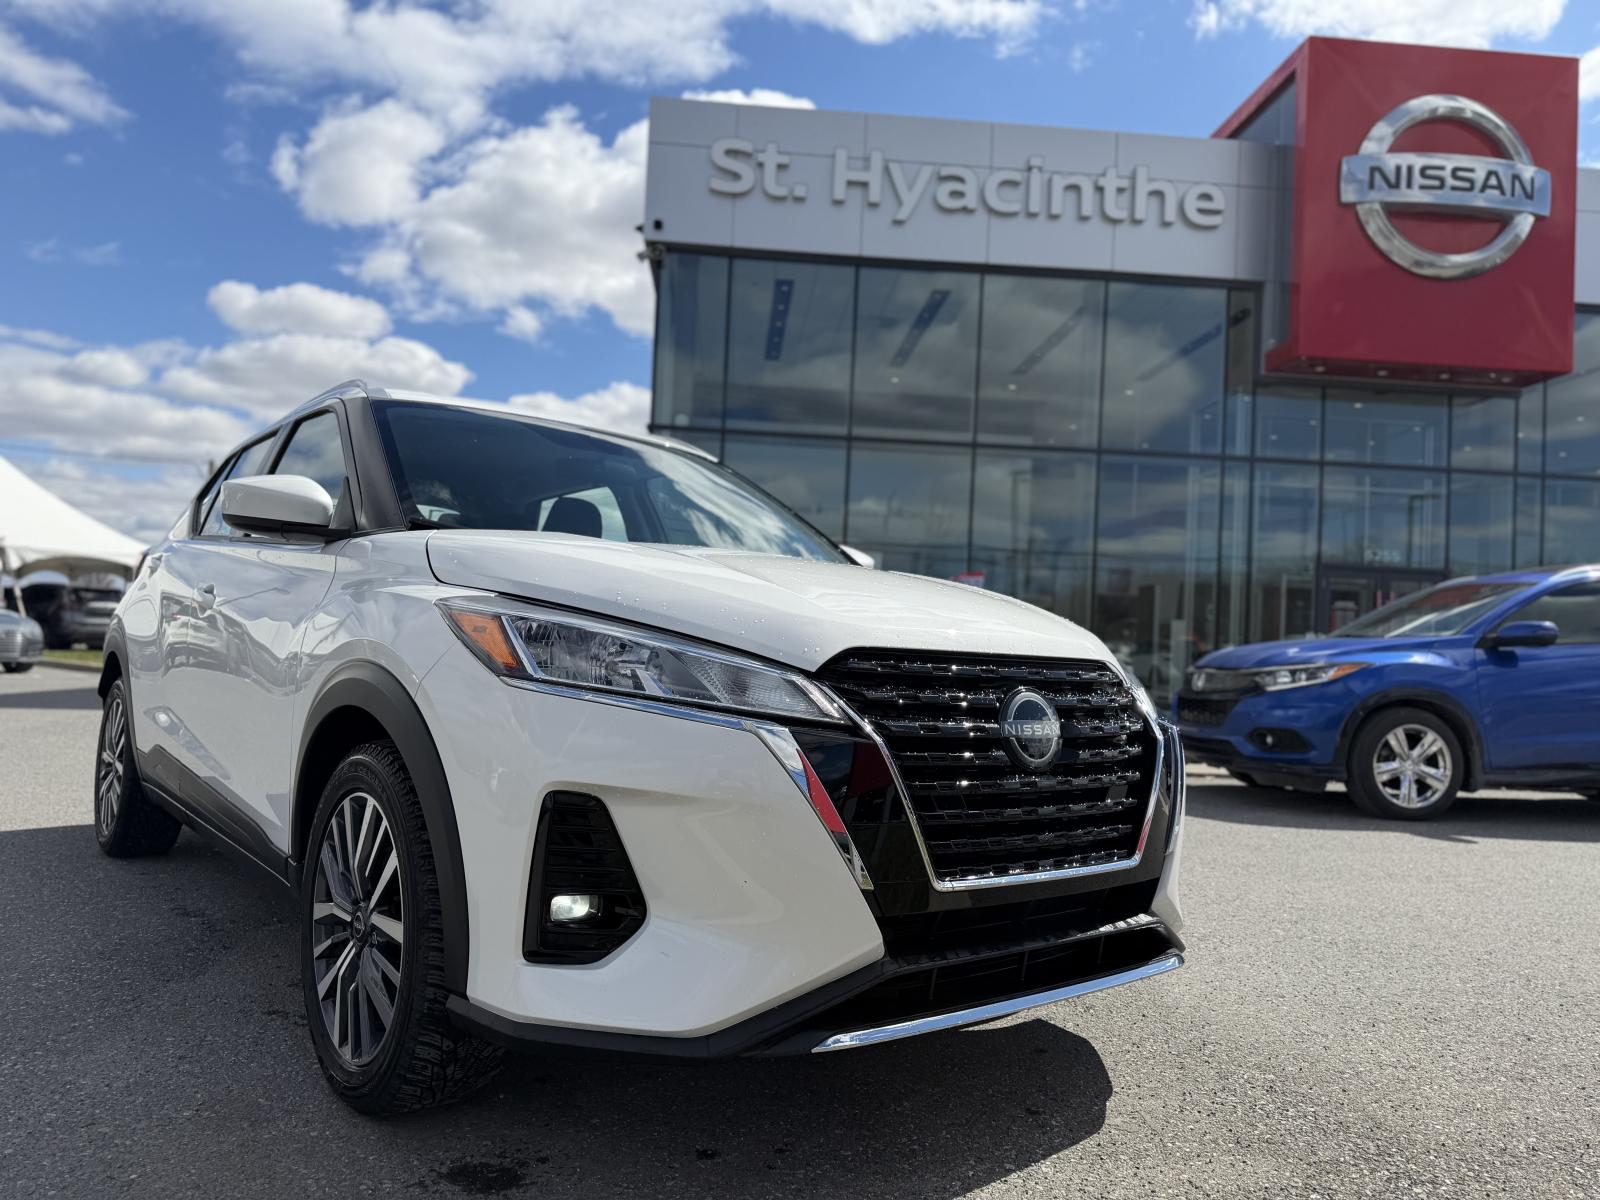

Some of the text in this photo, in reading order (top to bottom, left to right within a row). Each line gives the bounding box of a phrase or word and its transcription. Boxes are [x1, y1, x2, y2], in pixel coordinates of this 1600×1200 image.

[708, 137, 1226, 229] St. Hyacinthe
[1368, 164, 1535, 201] NISSAN
[1004, 723, 1059, 736] NISSAN
